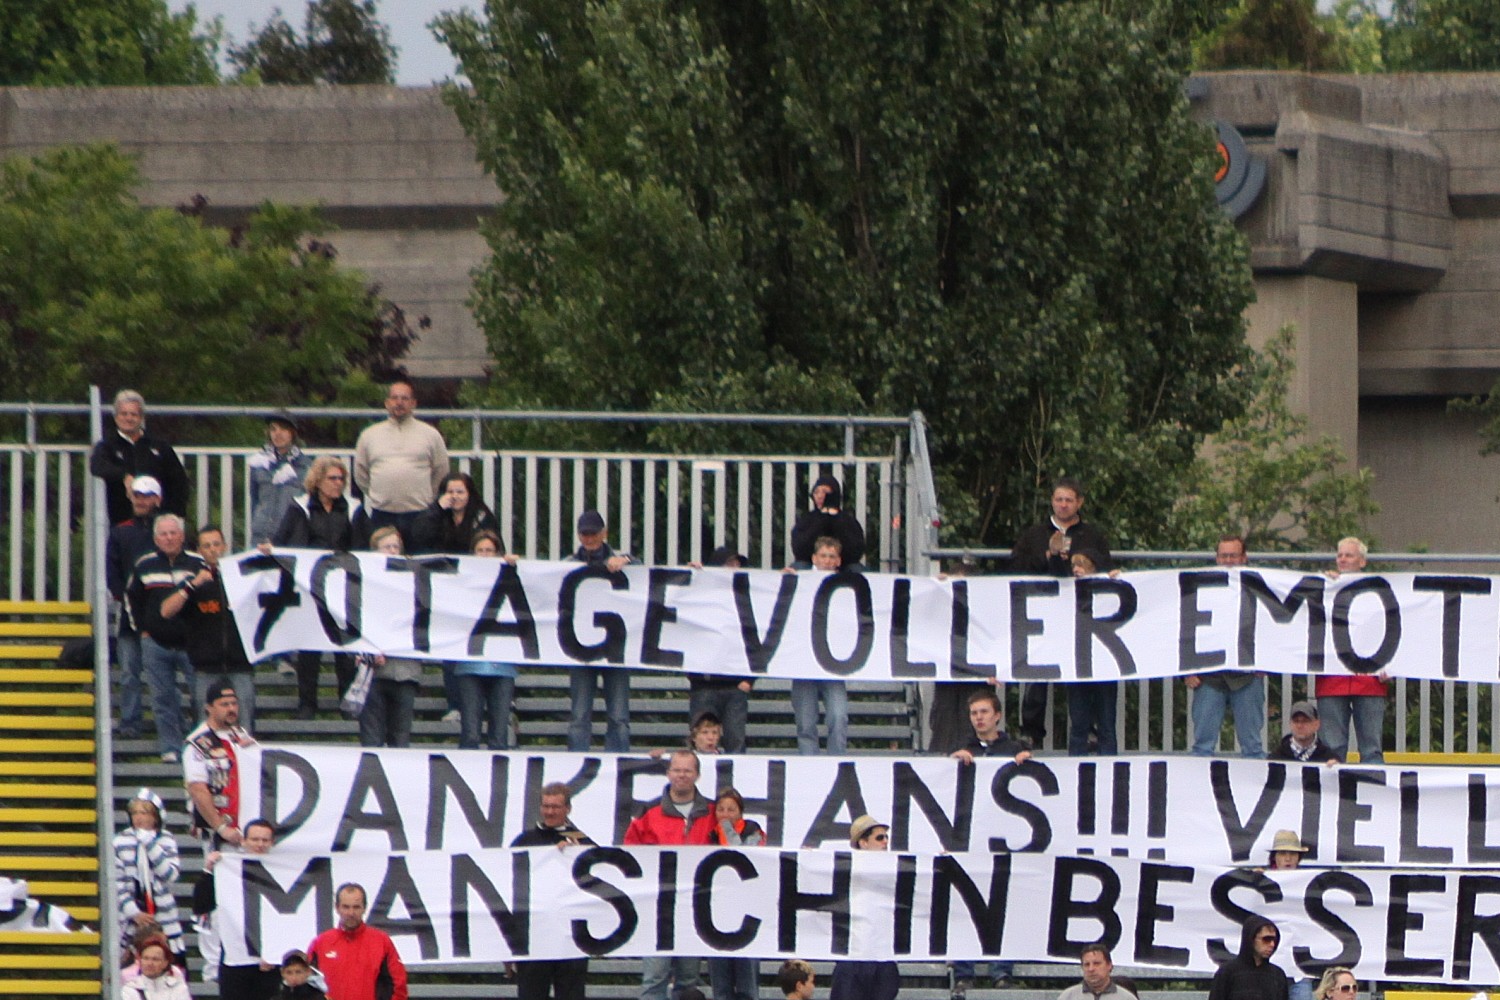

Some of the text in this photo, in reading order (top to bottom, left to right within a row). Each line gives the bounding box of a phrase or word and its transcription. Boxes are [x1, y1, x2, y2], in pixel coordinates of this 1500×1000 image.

[731, 571, 1138, 680] VOLLER
[241, 850, 530, 961] MAN
[571, 848, 851, 957] SICH
[893, 853, 1012, 956] IN
